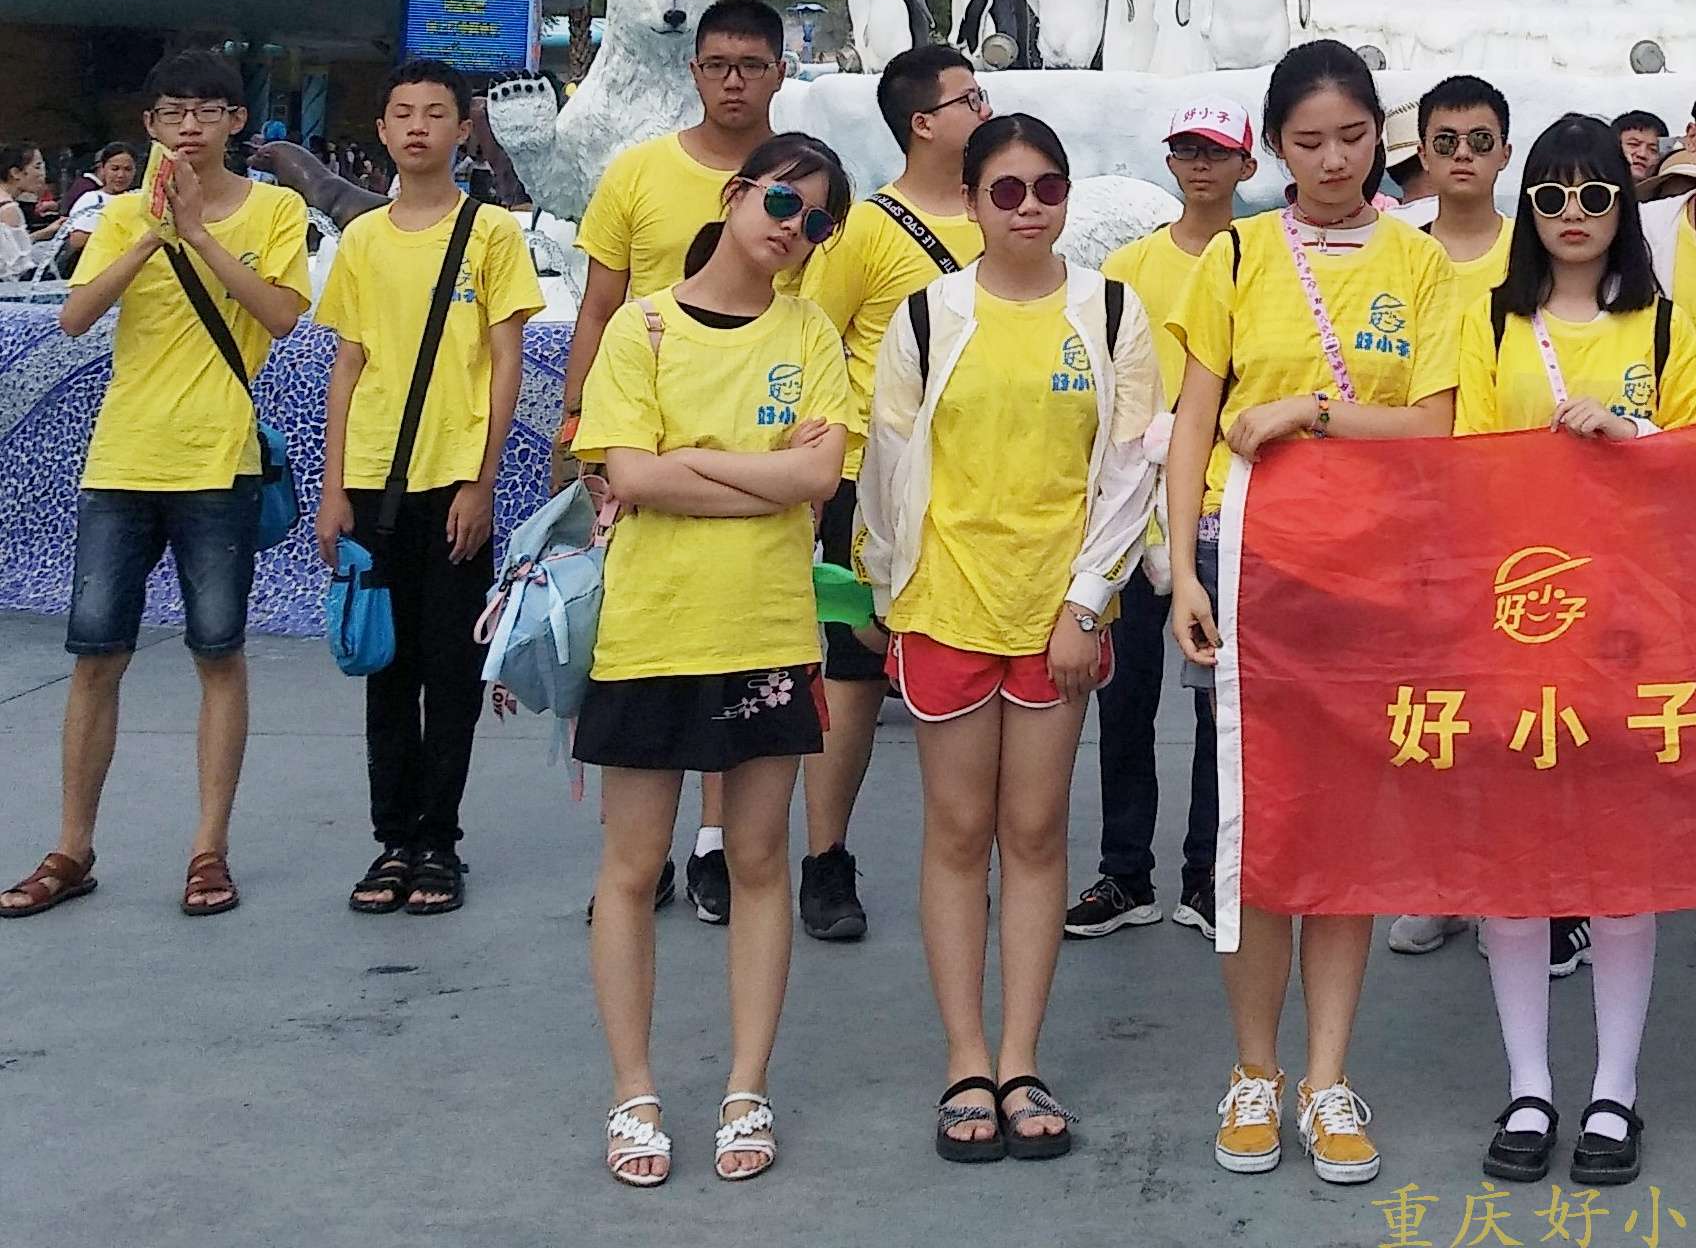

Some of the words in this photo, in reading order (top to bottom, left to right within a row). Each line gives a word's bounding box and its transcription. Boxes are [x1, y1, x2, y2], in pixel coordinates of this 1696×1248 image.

[1183, 107, 1231, 123] 好小子
[1355, 330, 1411, 358] 好小子
